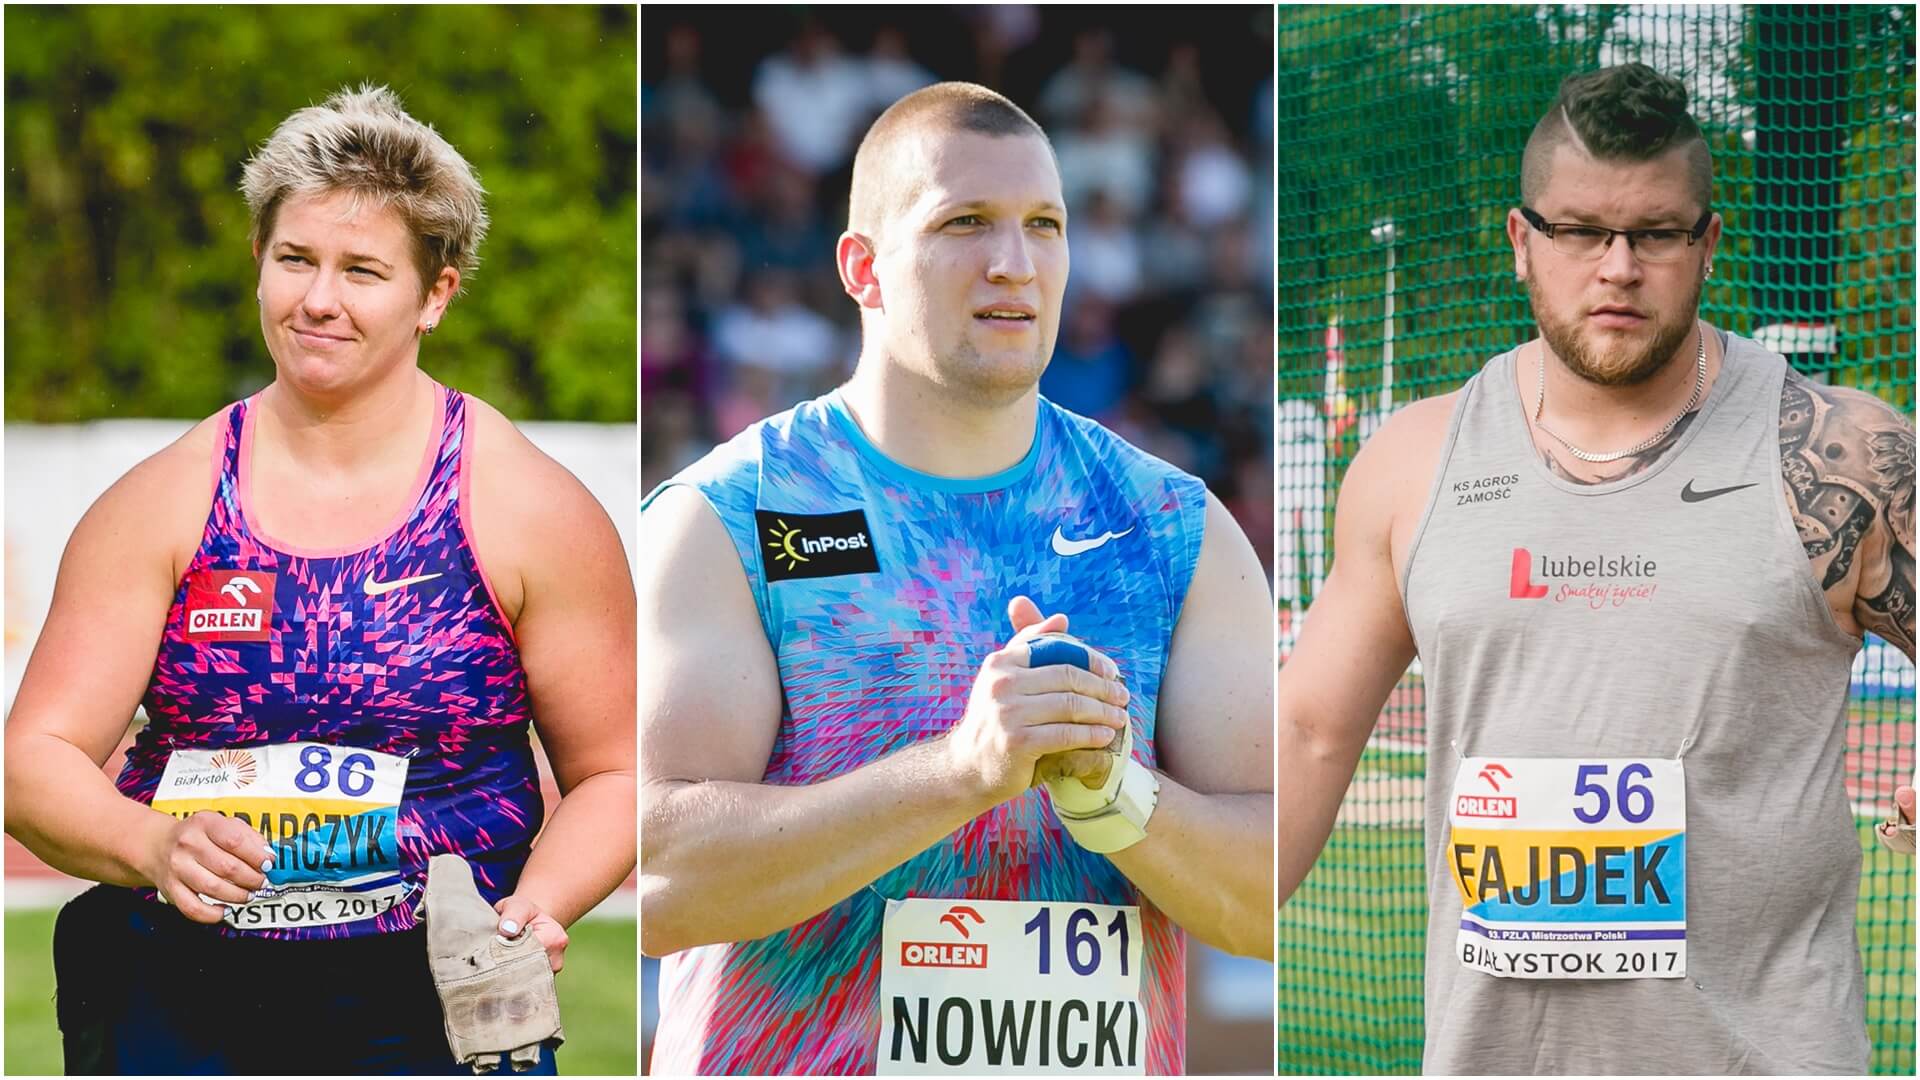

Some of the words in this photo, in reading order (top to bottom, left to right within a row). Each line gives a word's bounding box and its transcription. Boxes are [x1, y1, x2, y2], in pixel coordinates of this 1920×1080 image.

[1453, 481, 1470, 492] KS
[1473, 474, 1519, 490] AGROS
[801, 532, 868, 554] InPost
[1541, 554, 1657, 577] lubelskie
[1555, 583, 1610, 610] Smakuj
[193, 612, 256, 628] ORLEN
[174, 771, 230, 787] Białystok
[294, 745, 376, 797] 86
[1458, 797, 1514, 817] ORLEN
[1573, 763, 1655, 824] 56
[171, 811, 388, 872] ARCZYK
[1454, 844, 1672, 906] FAJDEK
[231, 900, 326, 924] YSTOK
[336, 894, 396, 918] 2017
[1024, 907, 1129, 976] 161
[1503, 930, 1530, 940] PZLA
[1532, 930, 1593, 940] Mistrzostwa
[1595, 930, 1627, 940] Polski
[905, 945, 983, 965] ORLEN
[1463, 943, 1605, 973] BIAŁYSTOK
[1616, 952, 1679, 973] 2017
[890, 996, 1139, 1068] NOWICKI
